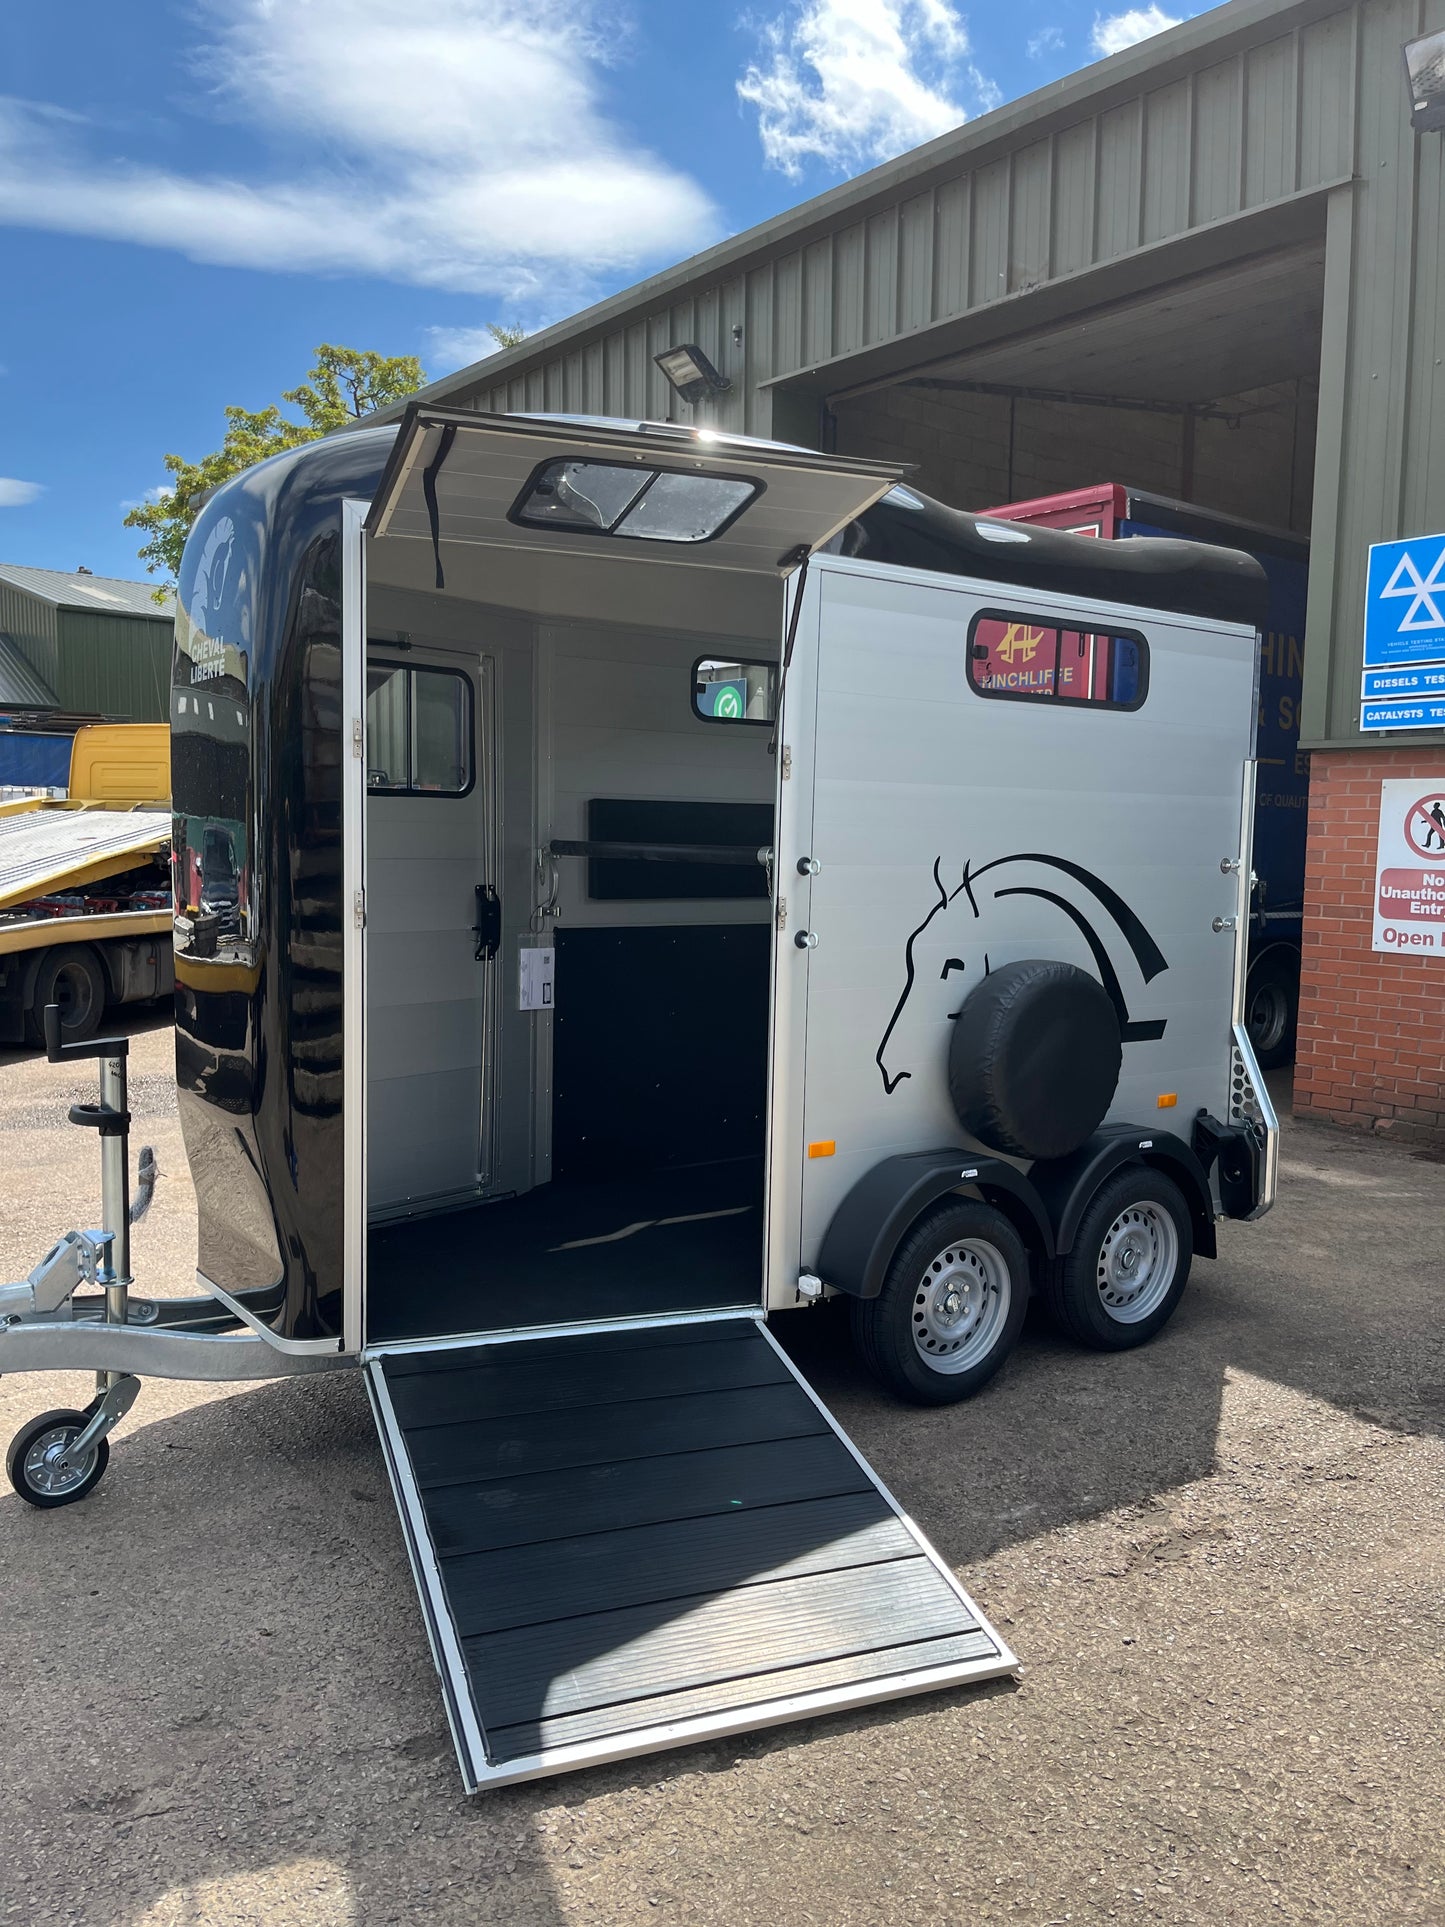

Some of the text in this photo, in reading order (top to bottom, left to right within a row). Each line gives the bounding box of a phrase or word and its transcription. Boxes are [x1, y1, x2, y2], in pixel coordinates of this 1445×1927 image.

[191, 635, 225, 663] CHEVAL
[190, 654, 225, 685] LIBERTÉ
[982, 667, 1074, 689] HINCHLIFE
[1373, 674, 1445, 688] DIESELS TES
[1279, 695, 1302, 731] S
[1366, 709, 1424, 720] CATALYSTS
[1423, 873, 1445, 887] No
[1381, 886, 1445, 901] Unautho
[1410, 901, 1445, 918] Entr
[1382, 927, 1435, 948] Open
